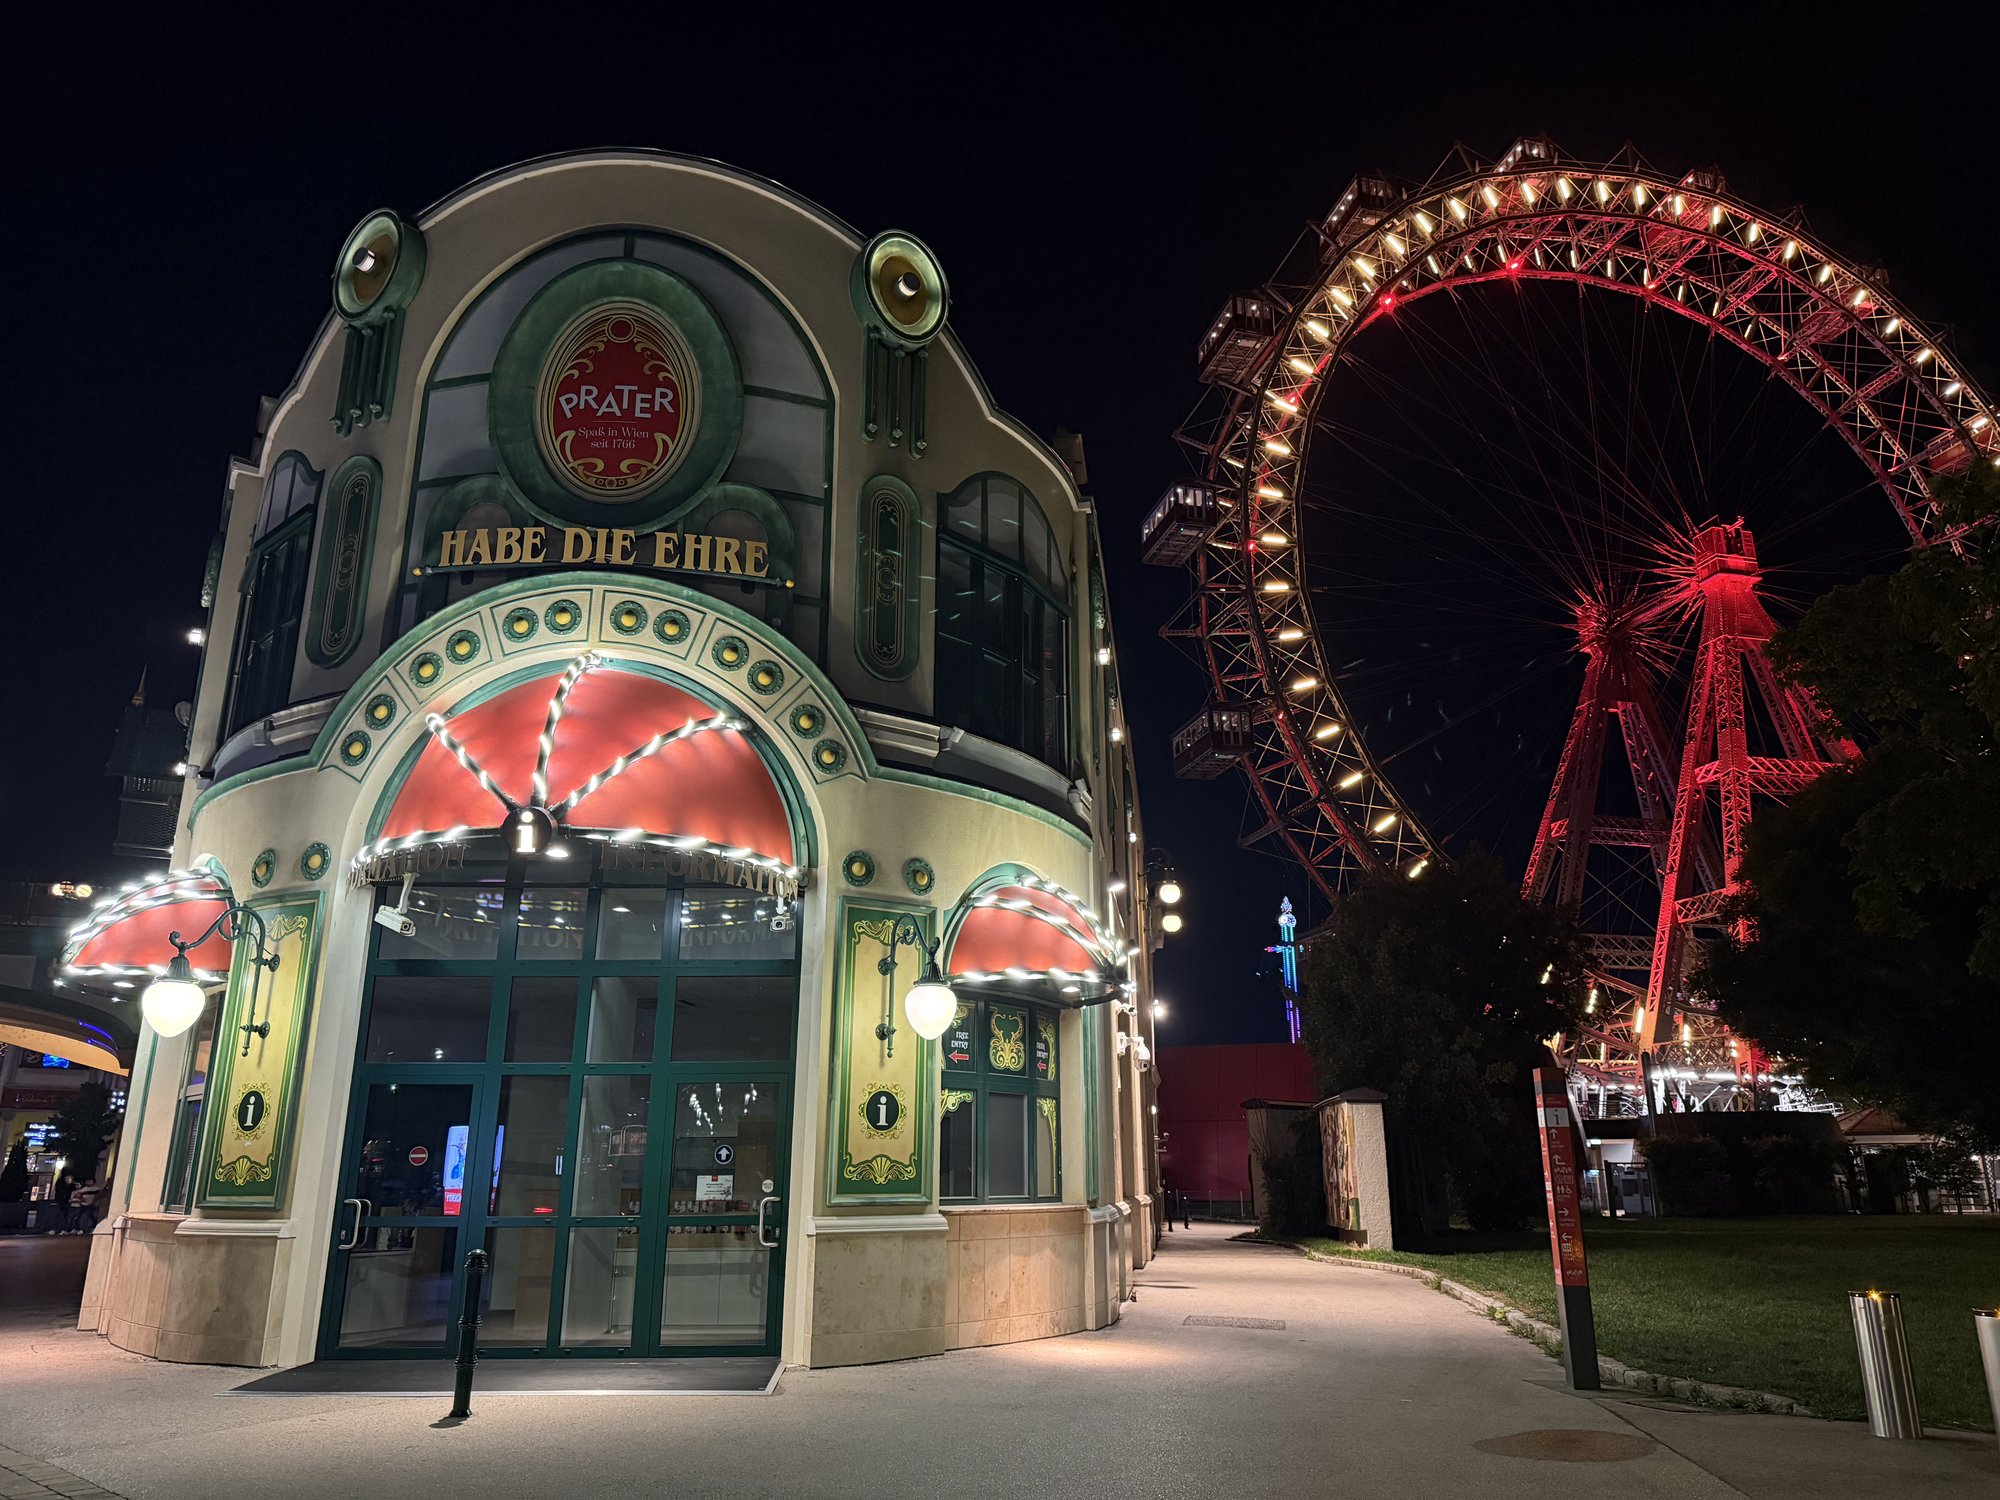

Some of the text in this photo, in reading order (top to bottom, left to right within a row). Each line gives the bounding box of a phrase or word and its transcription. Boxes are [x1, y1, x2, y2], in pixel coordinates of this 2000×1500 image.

[559, 385, 675, 419] PRATER
[578, 427, 649, 439] Spaß in Wien
[590, 439, 636, 449] seit 1766
[438, 526, 770, 578] HABE DIE EHRE
[599, 842, 800, 903] INFORMATION
[955, 1031, 969, 1040] FREE
[951, 1041, 969, 1049] ENTRY
